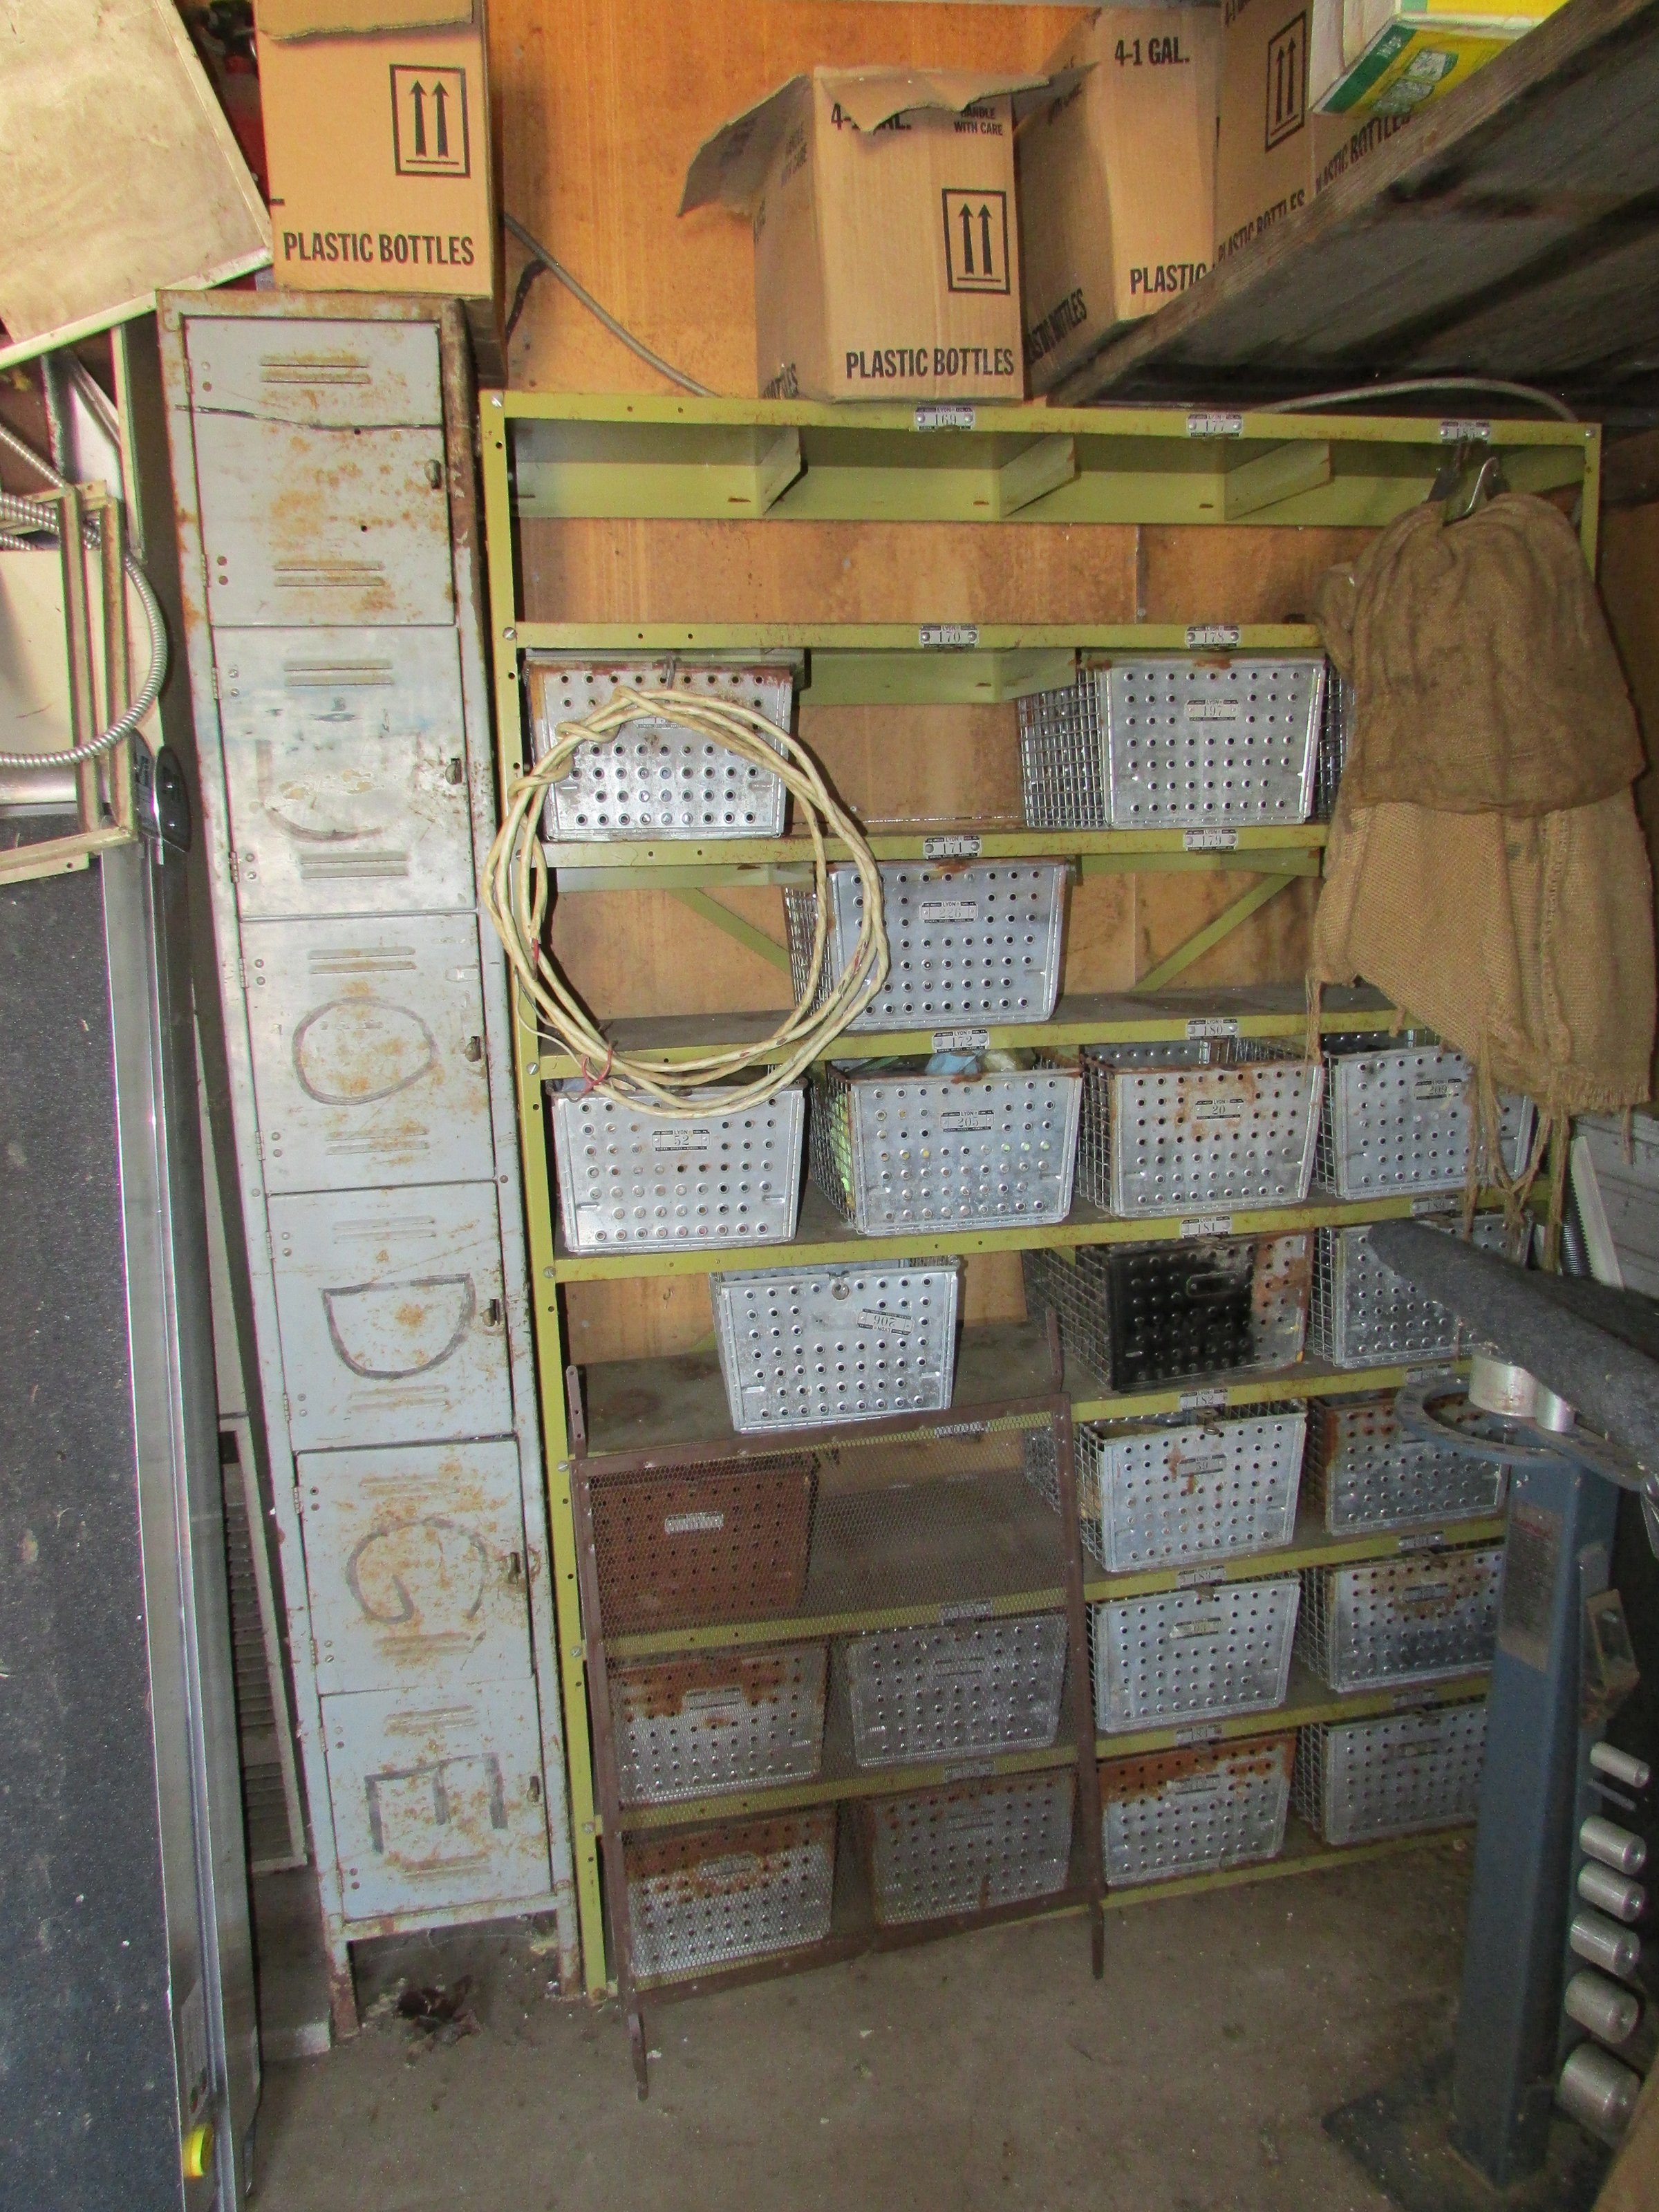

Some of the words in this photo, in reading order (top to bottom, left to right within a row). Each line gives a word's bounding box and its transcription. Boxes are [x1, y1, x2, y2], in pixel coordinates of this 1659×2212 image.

[1114, 39, 1143, 66] 4-1
[1148, 37, 1190, 66] GAL.
[954, 122, 977, 133] WITH
[980, 122, 1002, 135] CARE
[283, 232, 374, 263] PLASTIC
[378, 233, 475, 266] BOTTLES
[846, 348, 928, 379] PLASTIC
[933, 348, 1014, 376] BOTTLES
[935, 414, 956, 426] 169
[1206, 420, 1224, 432] 177
[939, 632, 960, 643] 170
[1205, 632, 1224, 643] 178
[1204, 705, 1222, 716] 197
[1201, 835, 1220, 845] 179
[944, 842, 962, 854] 171
[939, 908, 961, 918] 226
[1204, 1024, 1223, 1035] 180
[953, 1036, 972, 1047] 172
[1212, 1106, 1226, 1114] 20
[957, 1116, 979, 1127] 205
[674, 1135, 689, 1146] 52
[1198, 1223, 1215, 1234] 181
[874, 1315, 897, 1327] 206
[1196, 1395, 1213, 1406] 182
